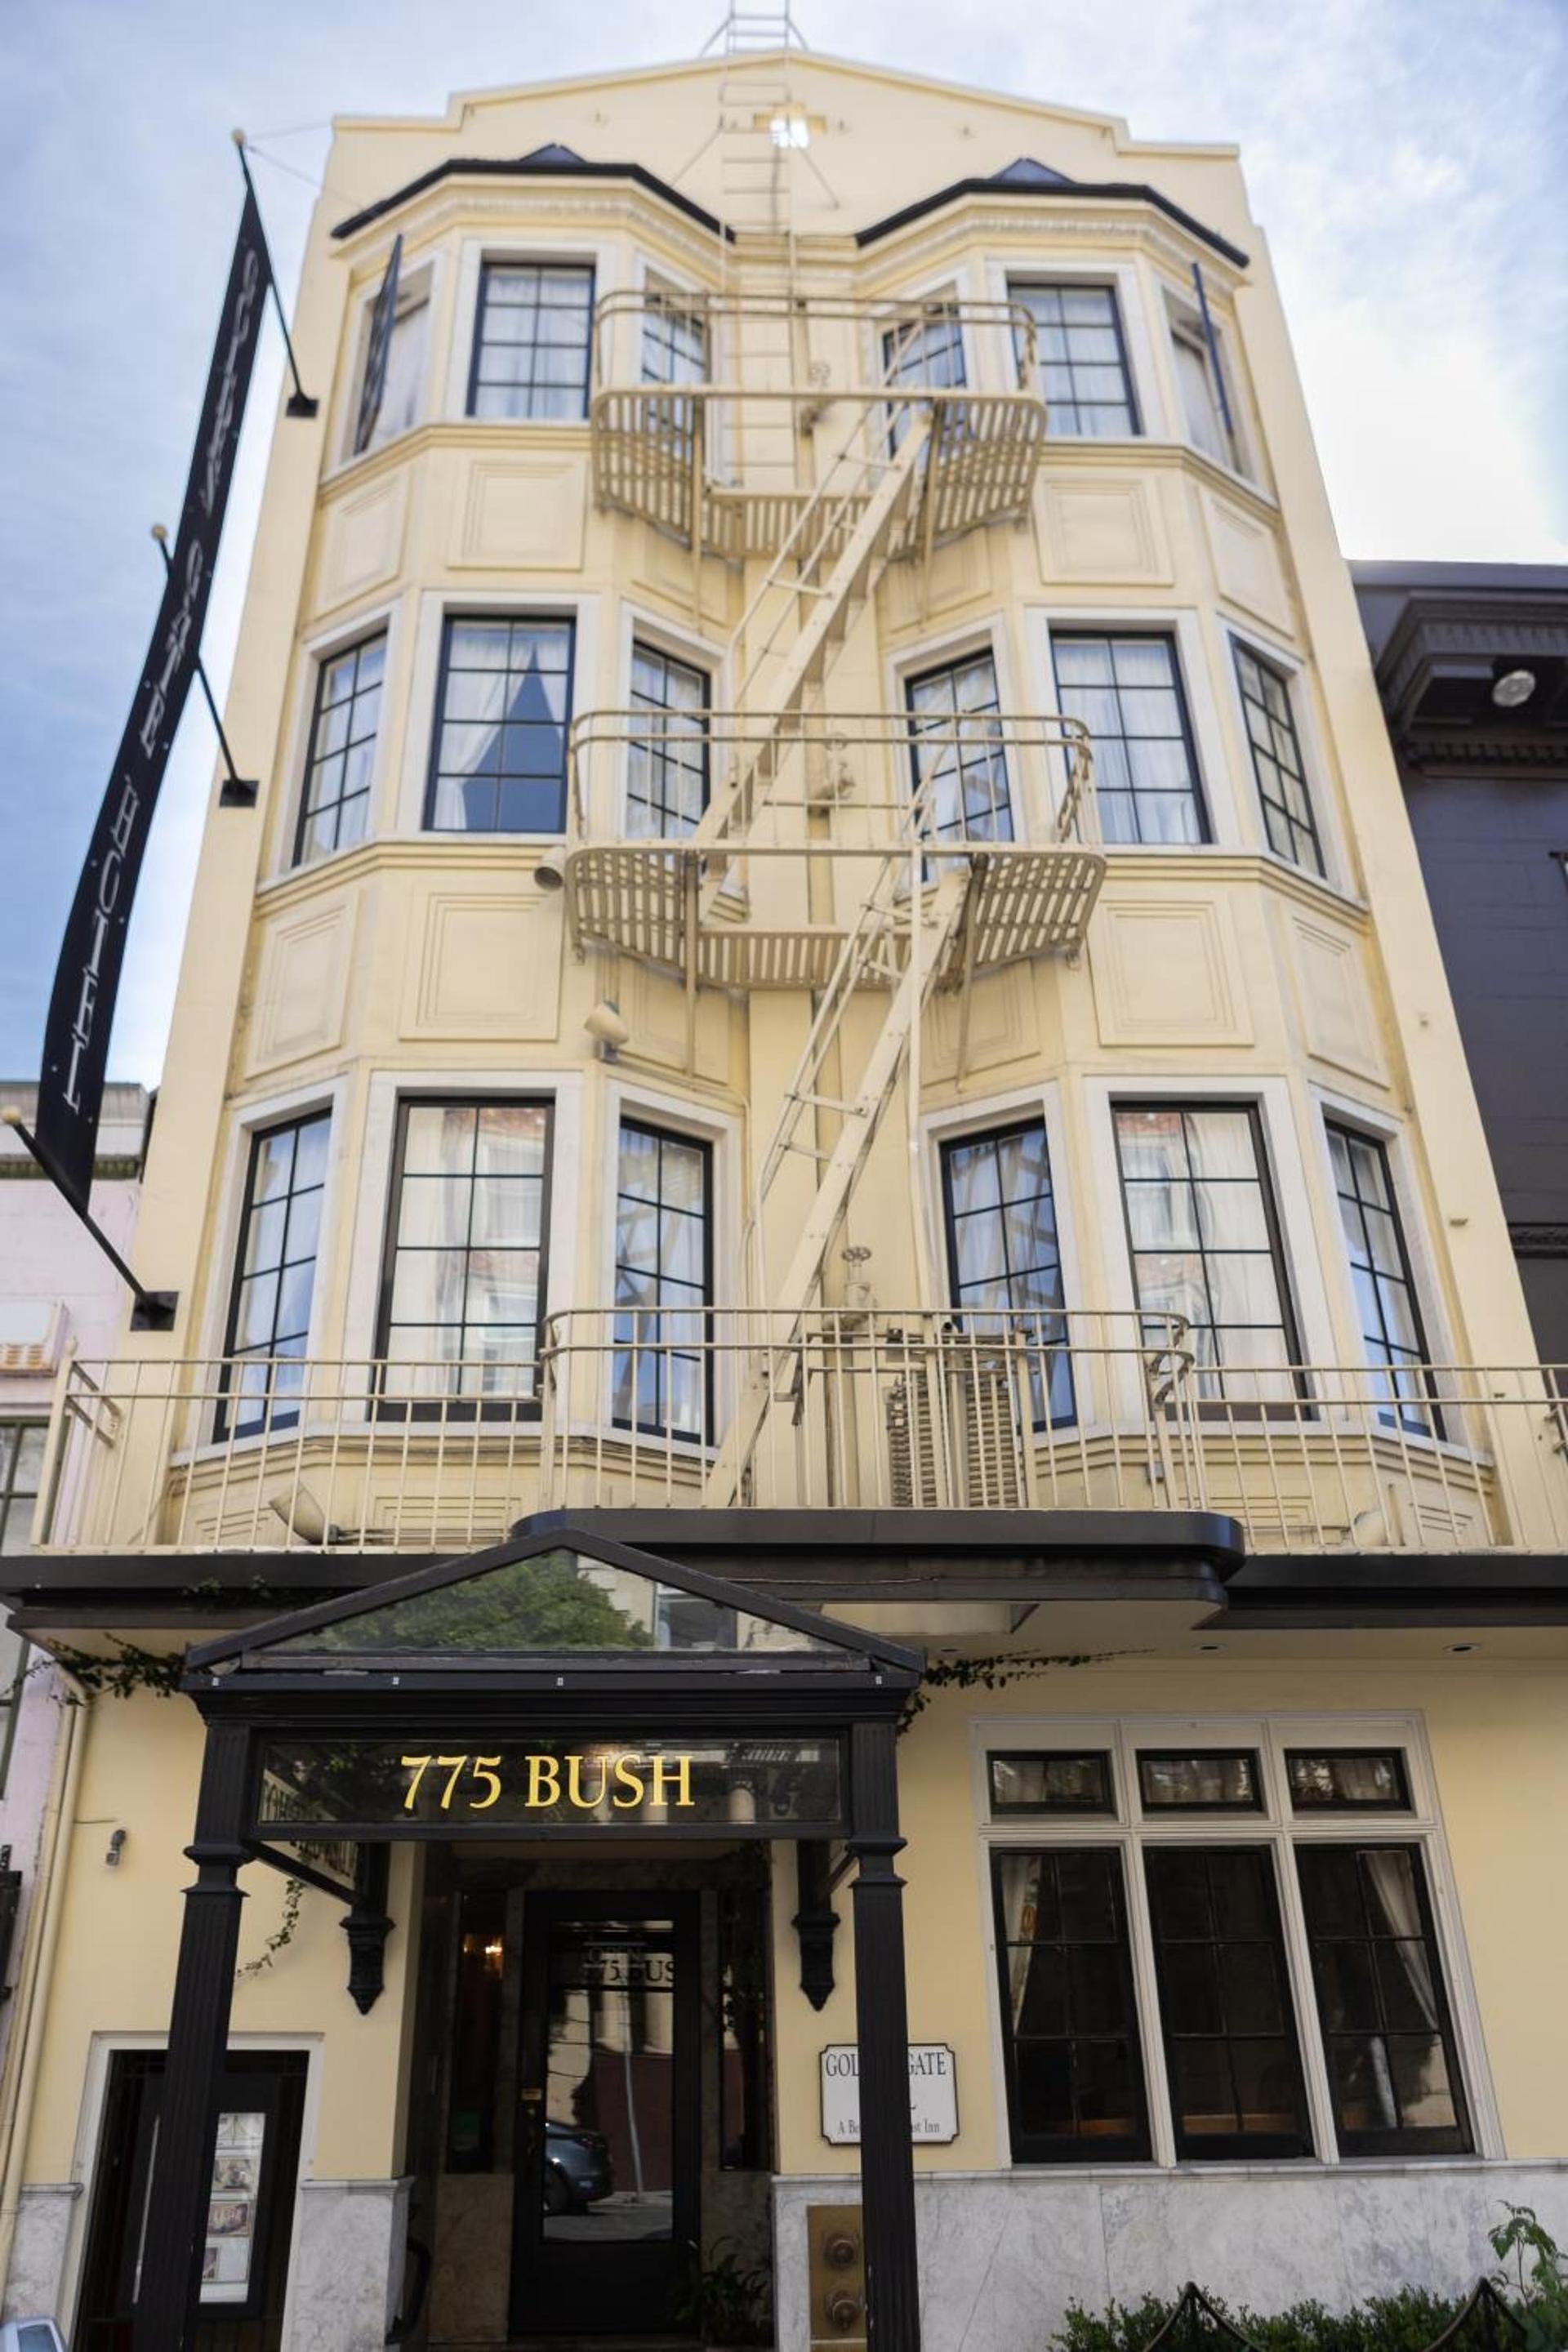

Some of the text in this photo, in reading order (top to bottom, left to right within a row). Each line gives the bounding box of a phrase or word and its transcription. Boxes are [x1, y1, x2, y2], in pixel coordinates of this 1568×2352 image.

[140, 540, 203, 760] GATE
[63, 774, 140, 1115] HOTEL
[400, 1754, 695, 1811] 775 BUSH
[826, 2051, 947, 2077] GOL GATE
[849, 2119, 860, 2134] Be
[924, 2118, 940, 2133] Inn
